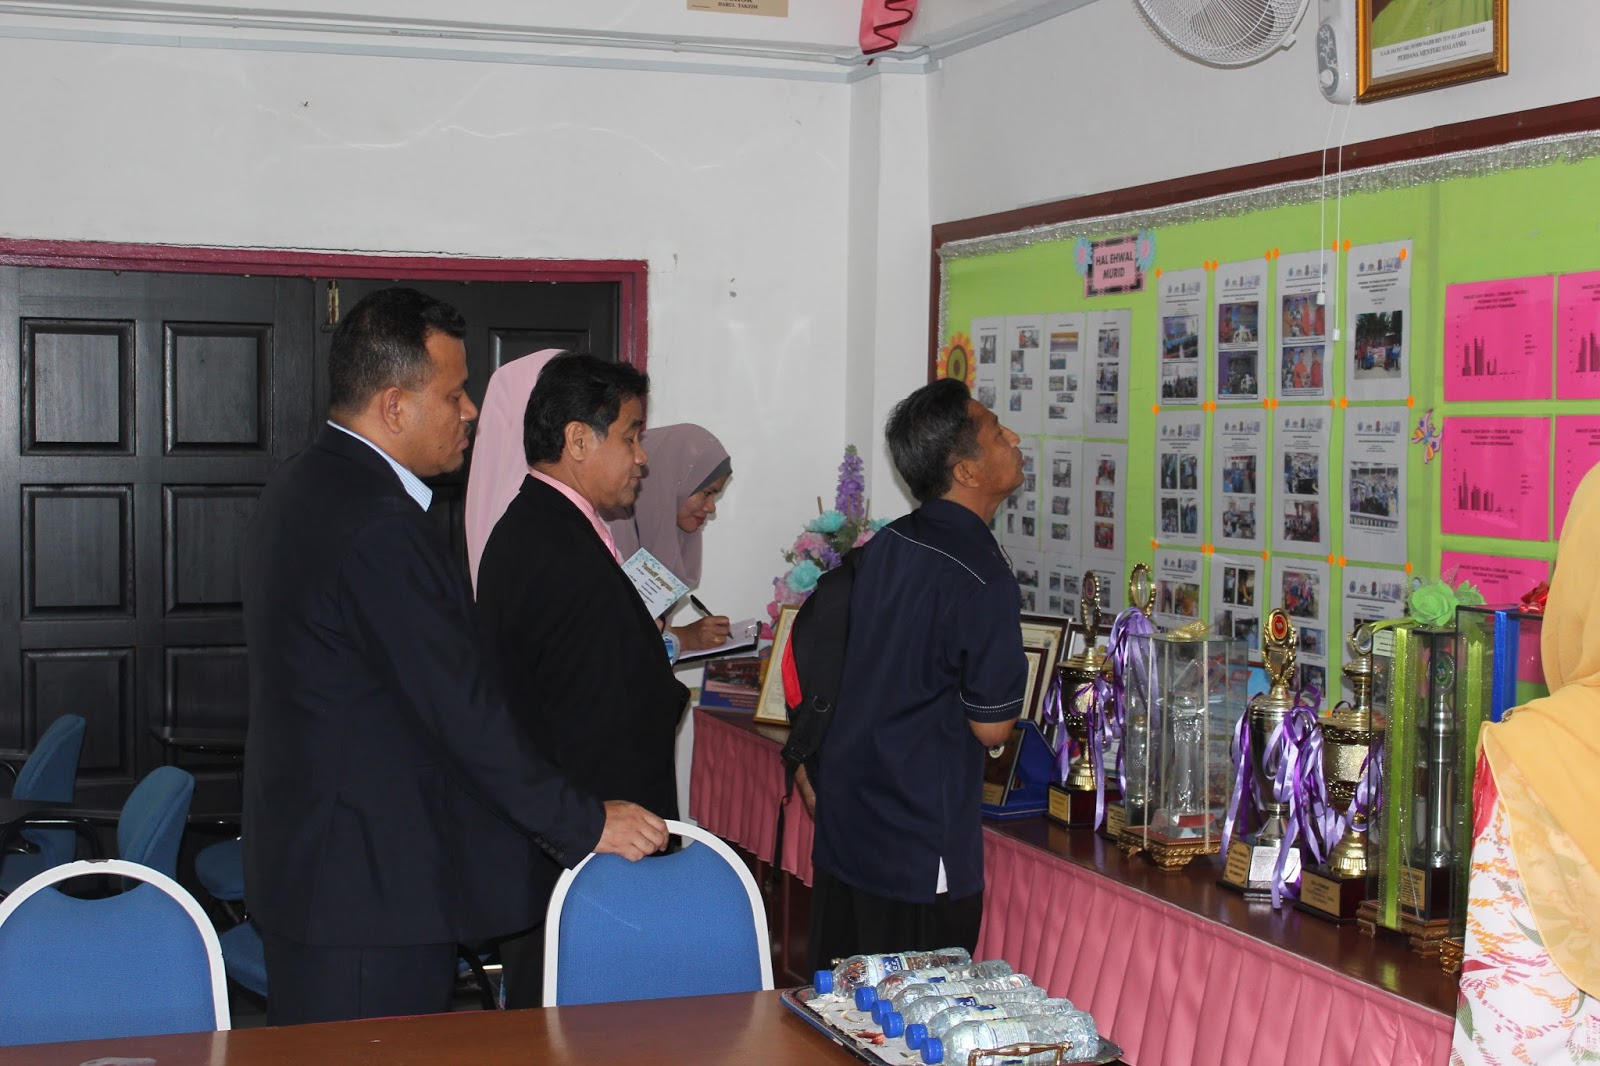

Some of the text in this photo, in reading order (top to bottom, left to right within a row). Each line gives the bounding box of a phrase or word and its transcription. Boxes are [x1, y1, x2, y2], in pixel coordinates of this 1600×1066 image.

[1397, 41, 1467, 61] PERDANA MENTERI MALAYSIA
[1096, 251, 1133, 266] HAL EHWAL
[1103, 268, 1125, 279] MURID
